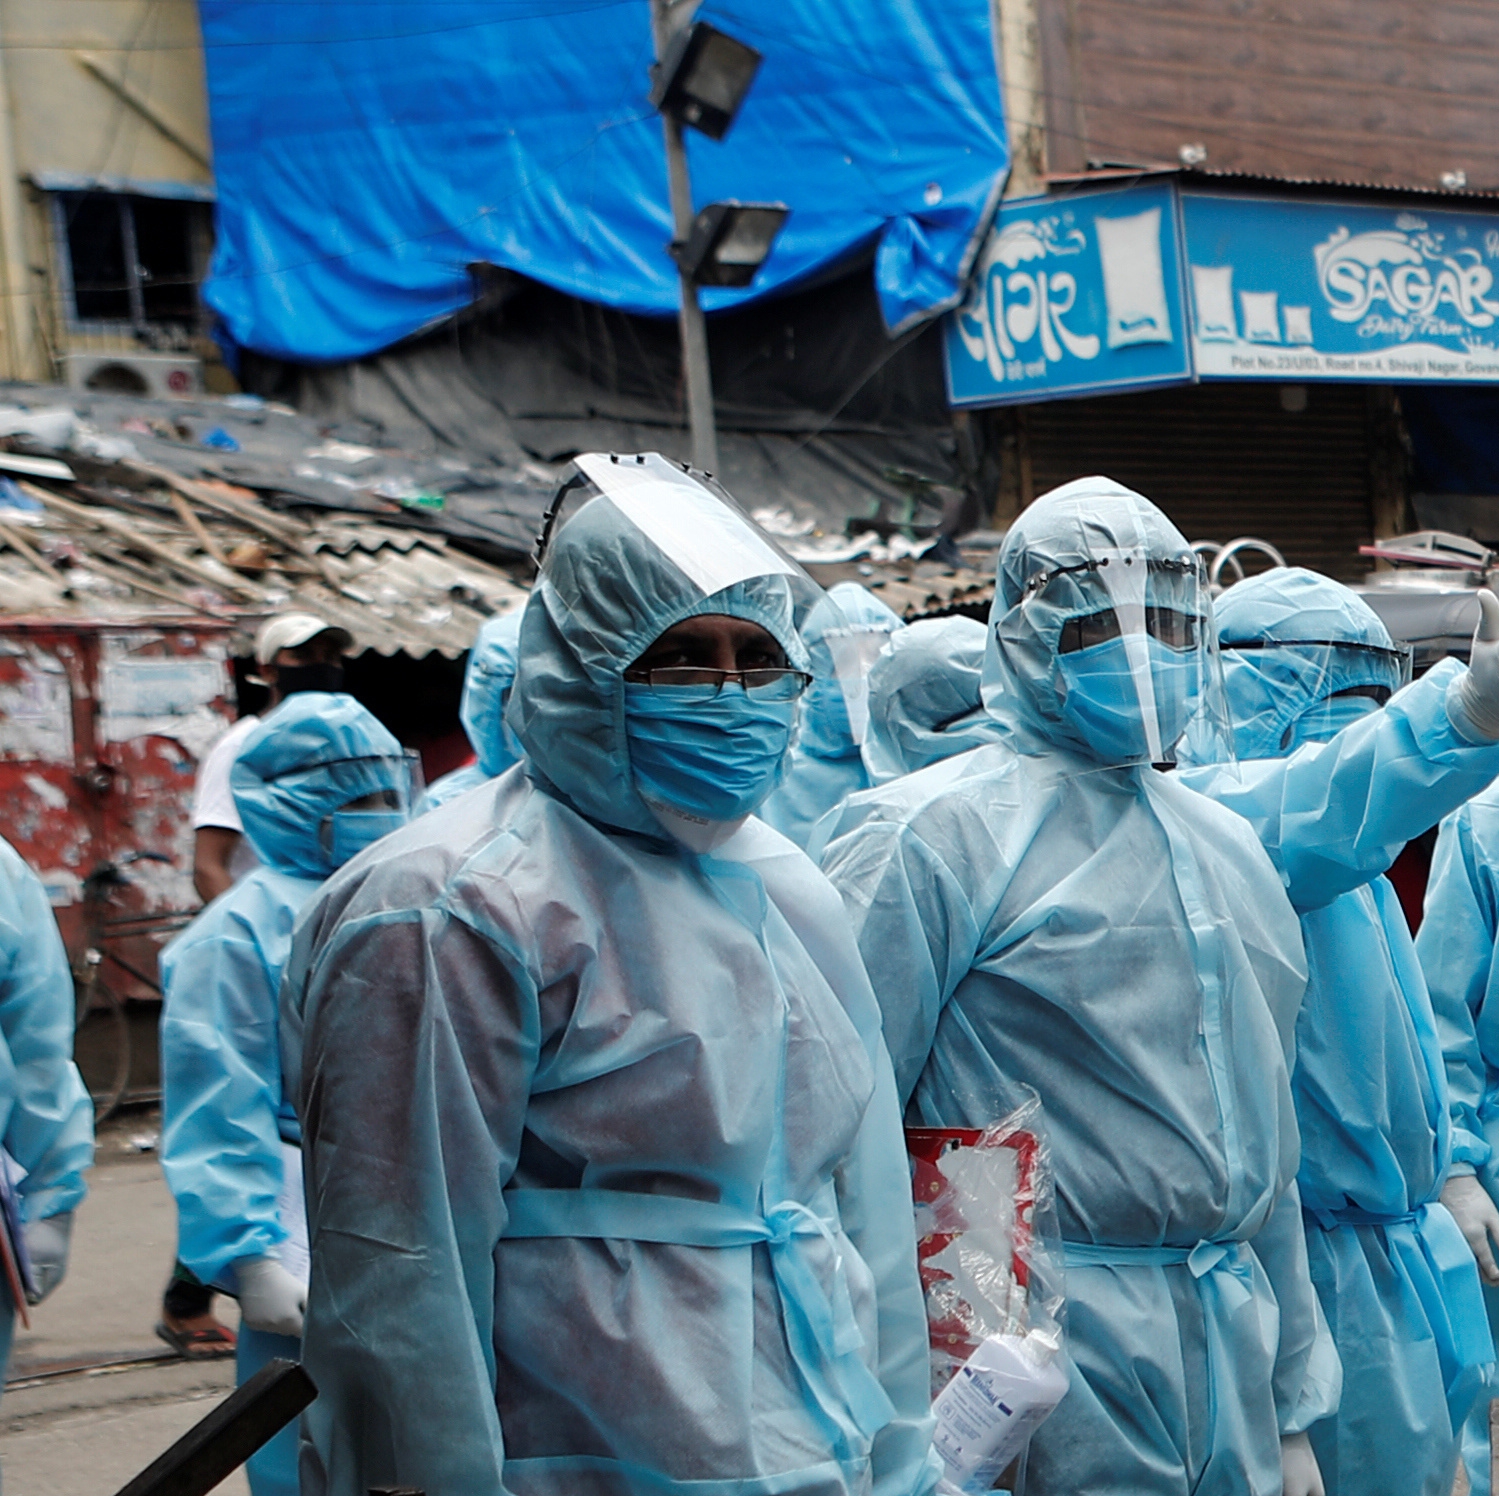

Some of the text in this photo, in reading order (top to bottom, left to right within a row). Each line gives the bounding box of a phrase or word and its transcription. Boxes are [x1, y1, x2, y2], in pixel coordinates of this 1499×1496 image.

[1356, 313, 1463, 341] Dairy Farm
[1325, 355, 1356, 370] Road
